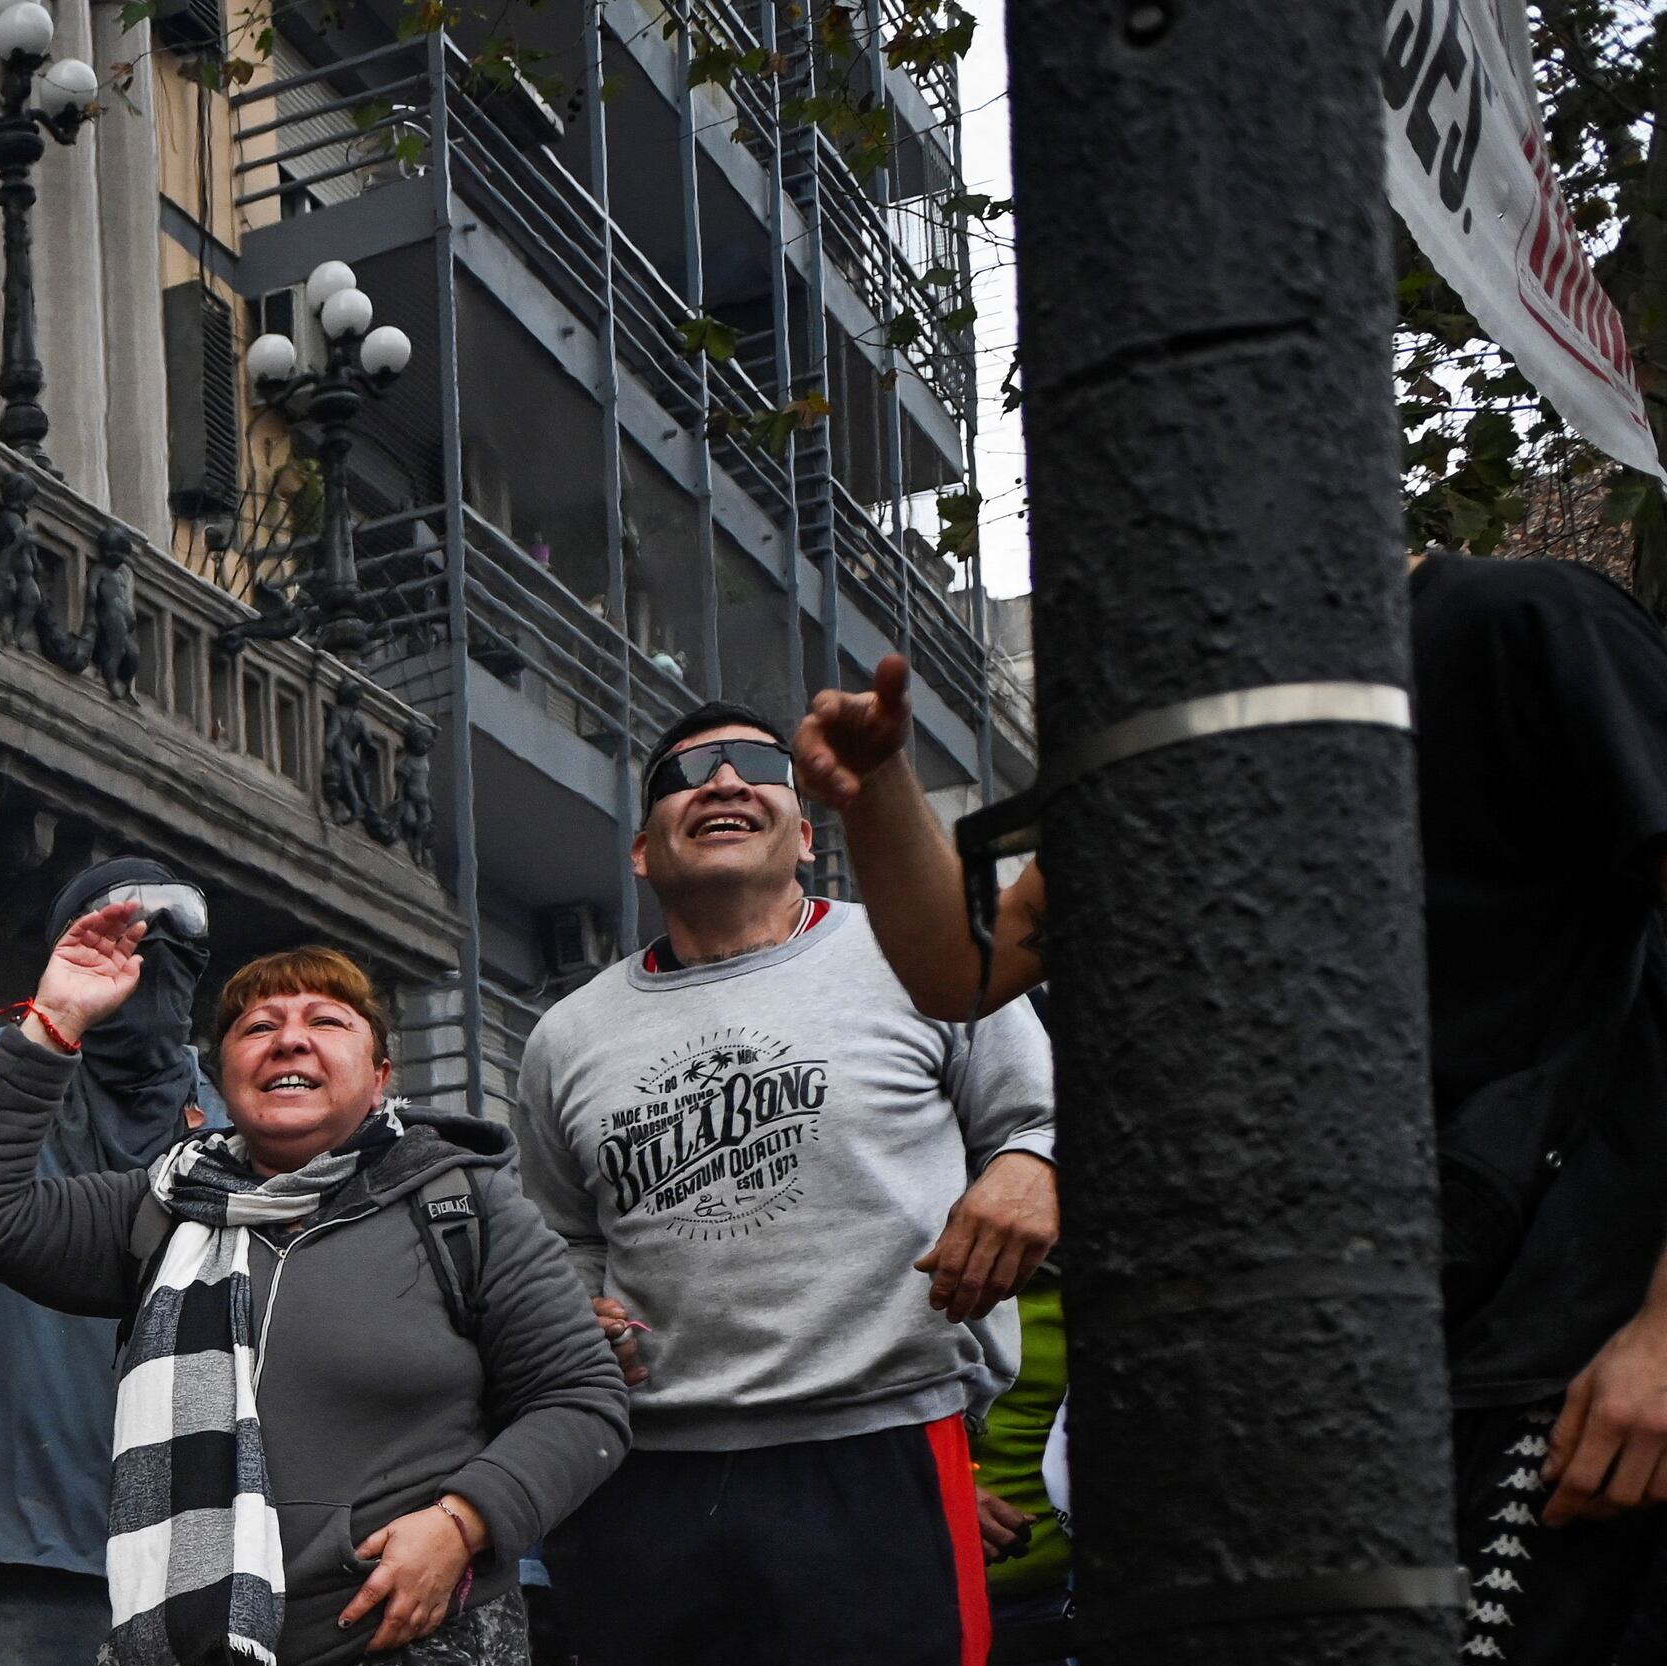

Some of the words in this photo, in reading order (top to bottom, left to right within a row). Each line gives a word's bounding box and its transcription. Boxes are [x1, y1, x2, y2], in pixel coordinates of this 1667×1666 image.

[597, 1066, 828, 1217] BILLABONG
[612, 1107, 641, 1130] MADE
[647, 1102, 668, 1119] FOR
[655, 1153, 726, 1212] PREMIUM
[729, 1124, 803, 1178] QUALITY
[769, 1153, 799, 1188] 1973
